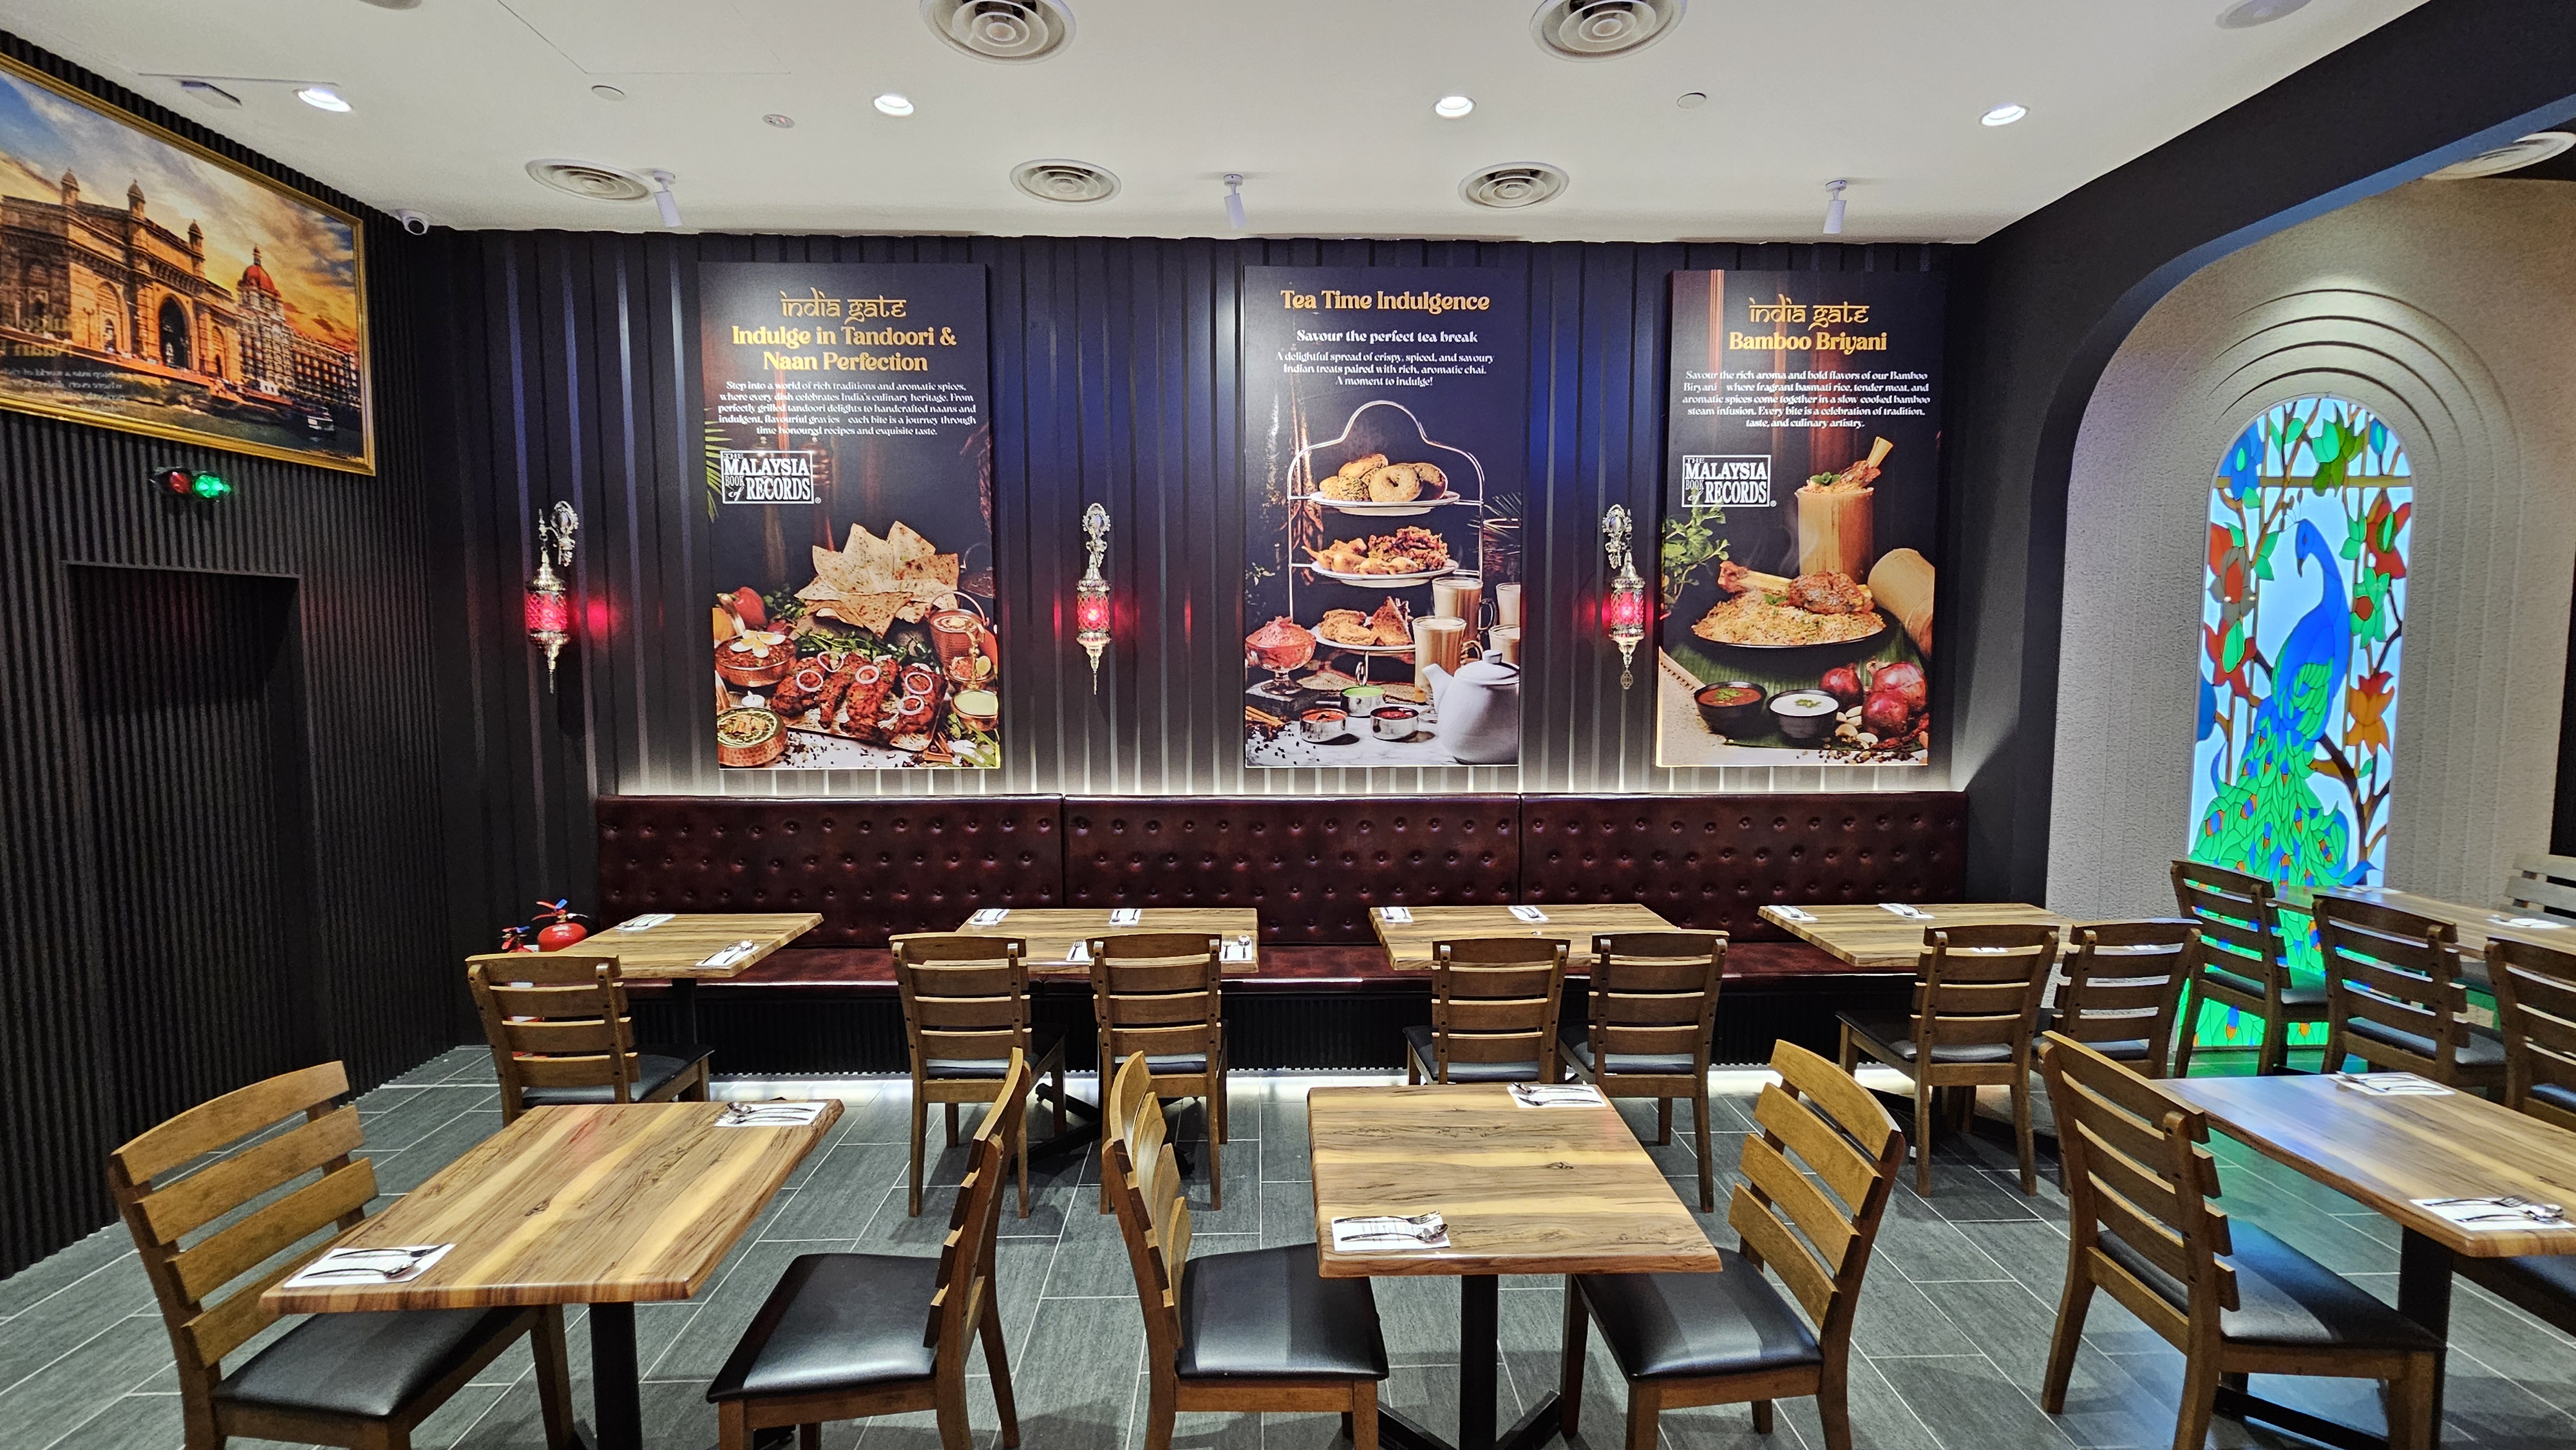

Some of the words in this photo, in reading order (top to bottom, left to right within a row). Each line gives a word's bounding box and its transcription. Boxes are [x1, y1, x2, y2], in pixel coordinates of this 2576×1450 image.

[779, 287, 840, 317] india
[844, 295, 907, 325] gate
[1280, 290, 1316, 309] Tea
[1321, 290, 1372, 309] Time
[1377, 291, 1490, 314] Indulgence
[1748, 294, 1807, 323] india
[1808, 301, 1870, 331] gate
[732, 326, 811, 349] Indulge
[817, 326, 837, 345] in
[840, 326, 934, 346] Tandoori
[940, 327, 957, 346] &
[1297, 330, 1343, 341] Savour
[1346, 330, 1367, 341] the
[1370, 330, 1414, 344] perfect
[1418, 332, 1437, 343] tea
[1440, 331, 1477, 343] break
[1728, 332, 1811, 350] Bamboo
[1816, 332, 1887, 355] Briyani
[764, 352, 818, 370] Naan
[823, 352, 928, 371] Perfection
[1276, 352, 1283, 361] A
[1285, 352, 1329, 362] delightful
[1330, 352, 1361, 362] spread
[1363, 352, 1373, 361] of
[1439, 353, 1457, 362] and
[1458, 355, 1494, 364] savoury
[1284, 364, 1315, 373] Indian
[1316, 364, 1343, 373] treats
[1344, 364, 1374, 375] paired
[1376, 364, 1396, 373] with
[1421, 365, 1463, 373] aromatic
[1464, 365, 1486, 374] chai.
[1685, 371, 1718, 379] Savour
[1719, 371, 1735, 379] the
[1736, 371, 1755, 379] rich
[1788, 371, 1806, 379] and
[1807, 371, 1828, 379] bold
[1829, 371, 1860, 379] flavors
[1861, 371, 1871, 379] of
[1890, 371, 1928, 380] Bamboo
[726, 381, 746, 391] Step
[748, 381, 766, 390] into
[775, 381, 800, 390] world
[802, 381, 811, 390] of
[813, 381, 831, 390] rich
[833, 382, 876, 390] traditions
[896, 382, 936, 391] aromatic
[1335, 376, 1343, 385] A
[1345, 377, 1383, 385] moment
[1396, 377, 1432, 388] indulge!
[1683, 382, 1717, 393] Biryani
[1726, 382, 1755, 391] where
[1757, 382, 1794, 393] fragrant
[1795, 383, 1832, 391] basmati
[749, 394, 772, 402] every
[872, 393, 909, 403] culinary
[911, 393, 948, 403] heritage.
[1725, 395, 1752, 405] spices
[1780, 395, 1817, 404] together
[1819, 395, 1828, 403] in
[717, 404, 756, 413] perfectly
[757, 404, 786, 413] grilled
[827, 404, 862, 413] delights
[875, 404, 928, 413] handcrafted
[958, 404, 976, 413] and
[1758, 407, 1785, 416] Every
[765, 415, 807, 423] flavourful
[809, 416, 840, 425] gravies
[848, 415, 869, 424] each
[905, 416, 938, 425] journey
[941, 416, 976, 425] through
[1771, 419, 1789, 427] and
[1790, 419, 1829, 429] culinary
[778, 426, 822, 435] honoured
[824, 427, 855, 435] recipes
[875, 427, 913, 436] exquisite
[724, 458, 810, 476] MALAYSIA
[1685, 462, 1767, 480] MALAYSIA
[725, 476, 744, 486] BOOK
[1685, 480, 1704, 490] BOOK
[728, 487, 744, 501] of
[746, 478, 810, 500] RECORDS
[1704, 482, 1766, 503] RECORDS
